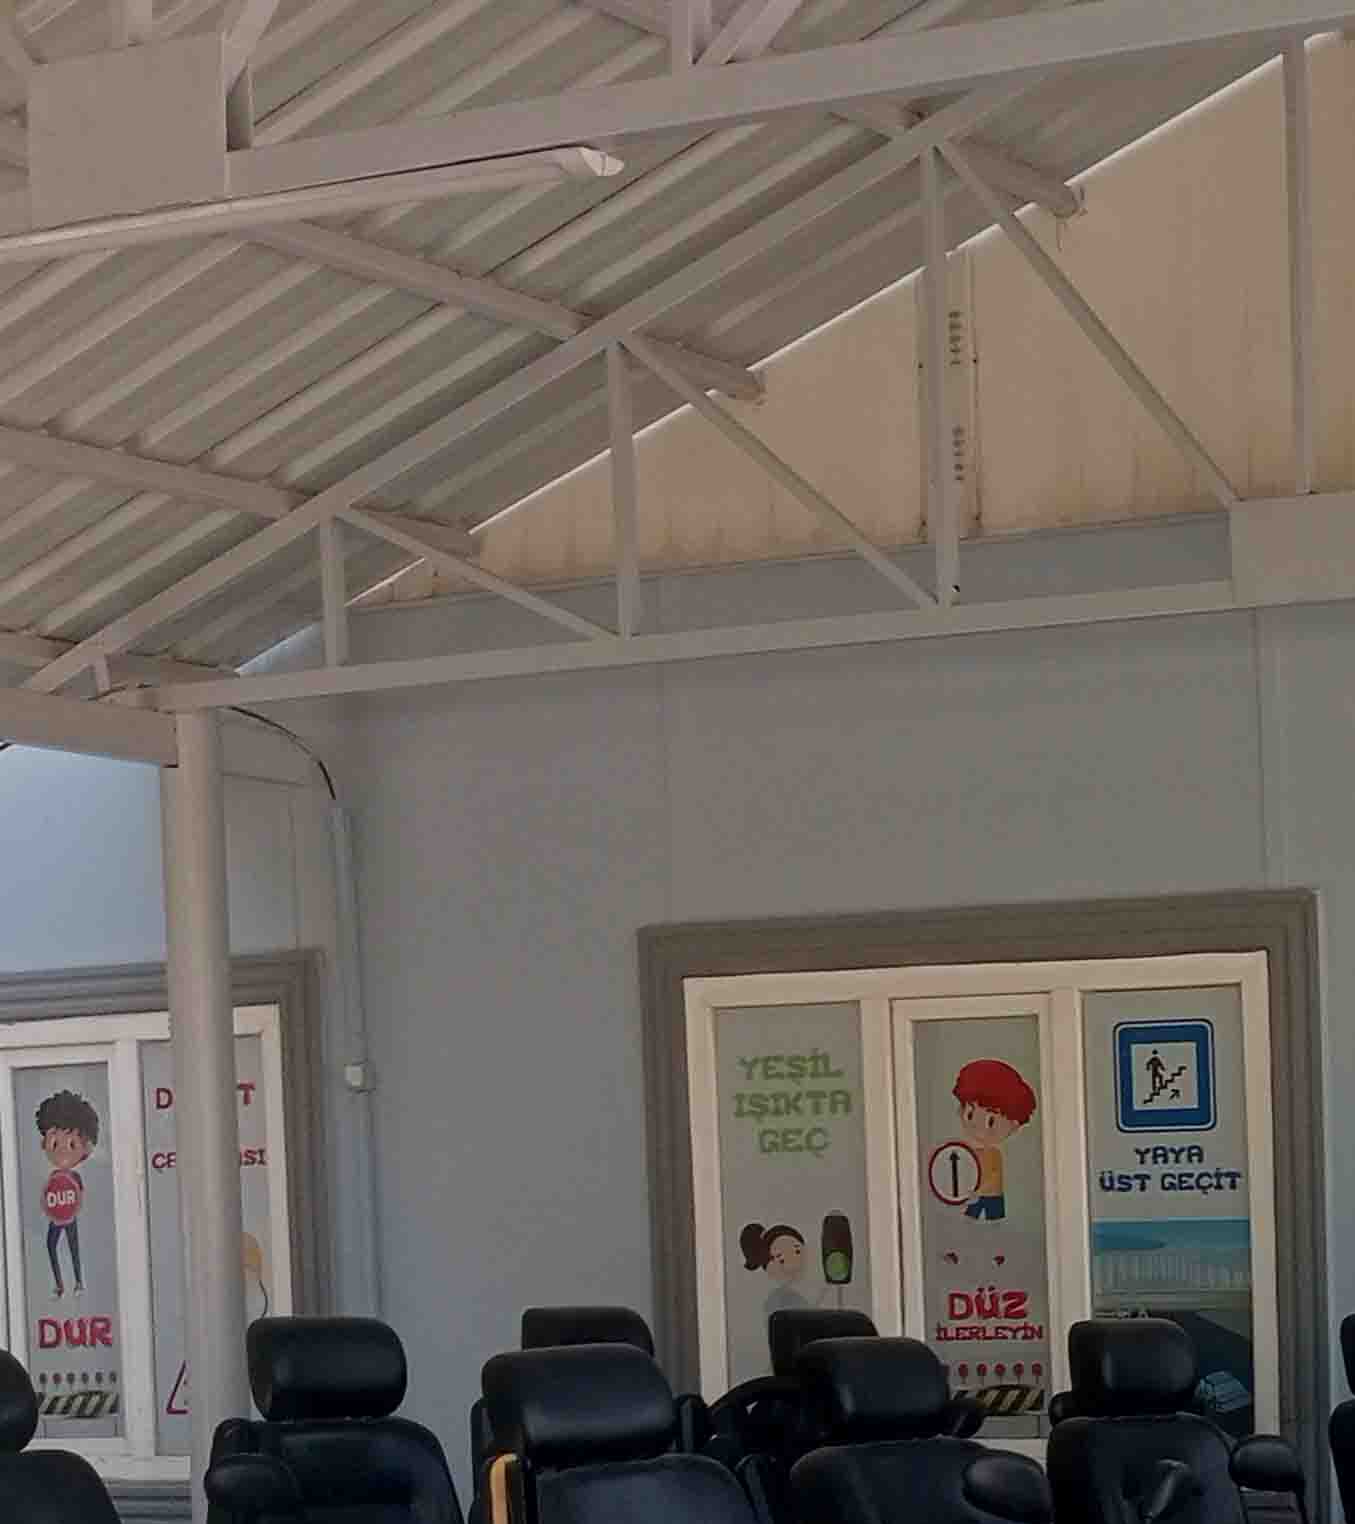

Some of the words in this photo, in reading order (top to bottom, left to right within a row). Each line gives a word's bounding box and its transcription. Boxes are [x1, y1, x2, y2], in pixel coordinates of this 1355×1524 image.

[737, 1052, 842, 1086] YEŞİL
[733, 1089, 852, 1120] IŞIKTA
[758, 1127, 829, 1158] GEÇ
[1133, 1145, 1205, 1166] YAYA
[1099, 1170, 1151, 1193] ÜST
[1159, 1167, 1242, 1194] GEÇİT
[47, 1190, 76, 1207] DUR
[947, 1288, 1029, 1320] DÜZ
[38, 1317, 113, 1350] DUR
[935, 1321, 1044, 1342] İLERLEYİN
